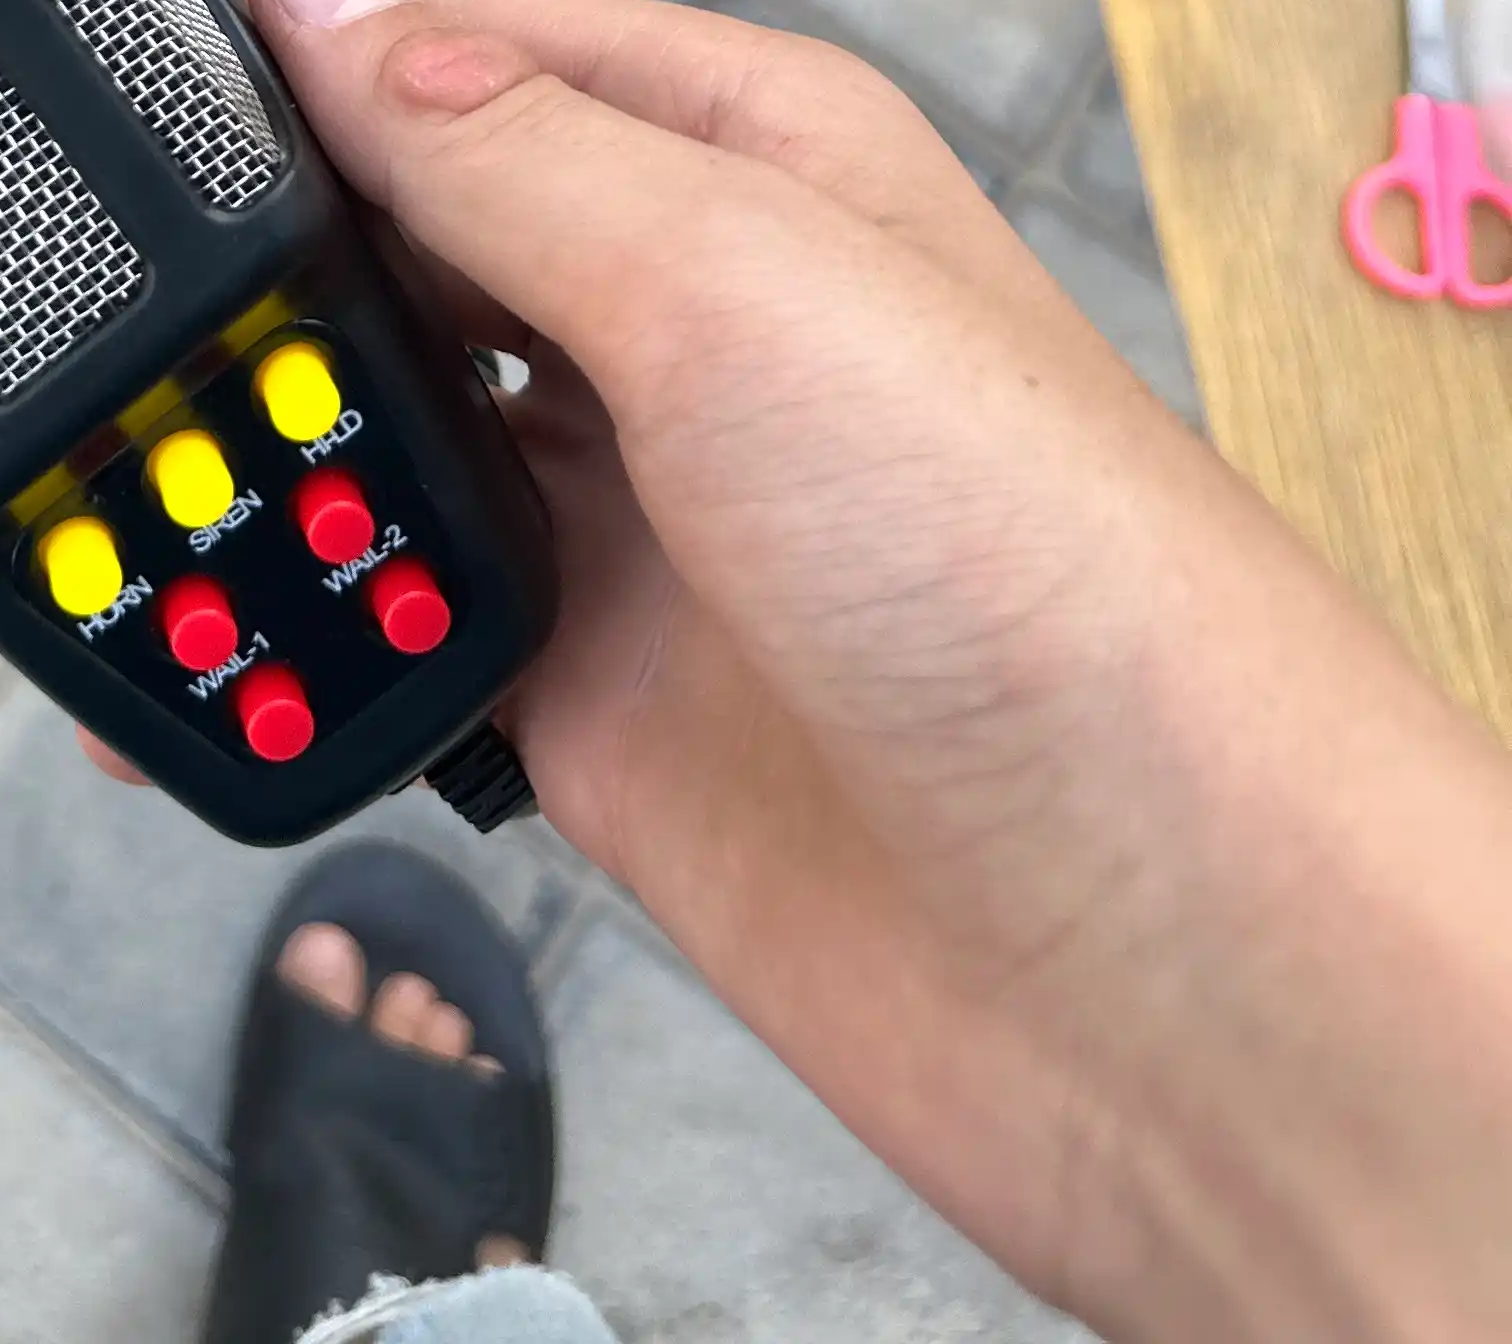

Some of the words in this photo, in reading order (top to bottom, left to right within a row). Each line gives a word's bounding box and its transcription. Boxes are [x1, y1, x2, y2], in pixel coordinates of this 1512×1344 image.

[189, 488, 264, 554] SIREN
[321, 524, 408, 594] WAIL-2
[76, 574, 153, 643] HORN
[187, 631, 270, 699] WAIL-1
